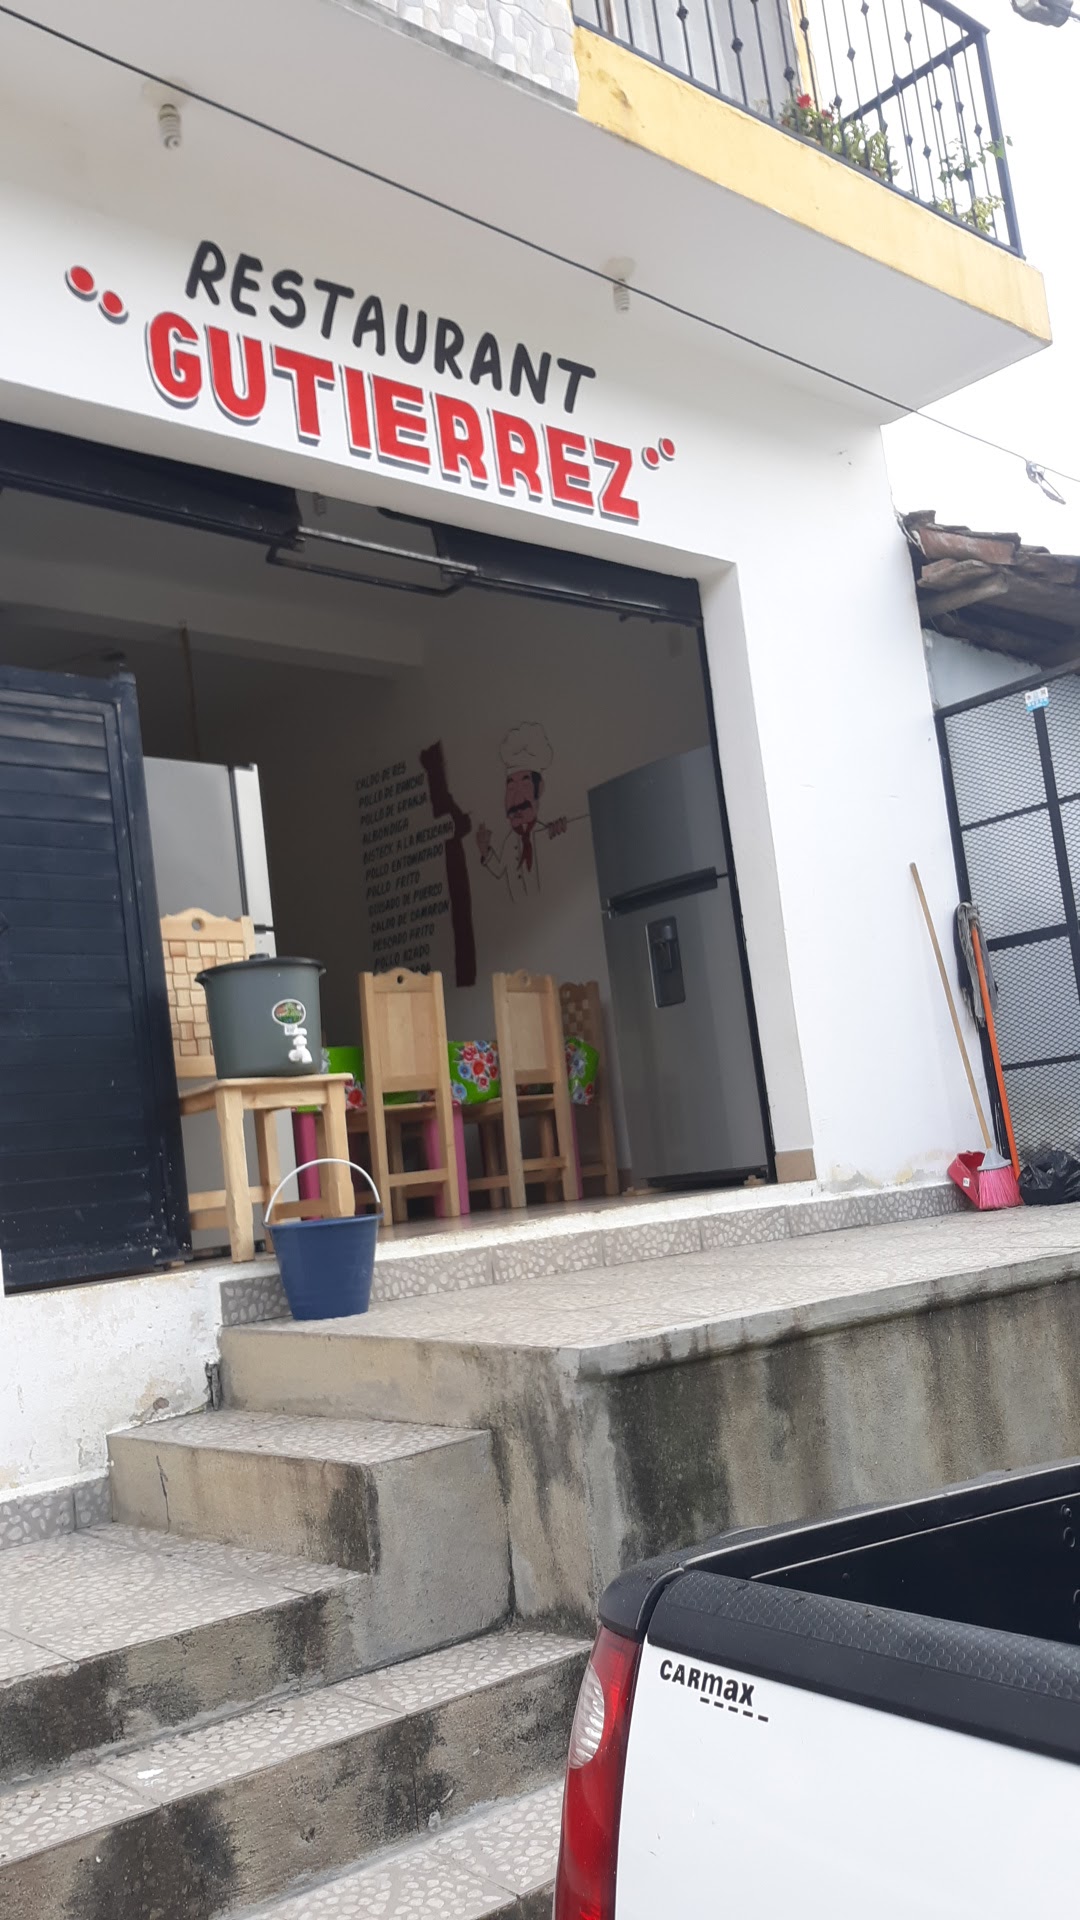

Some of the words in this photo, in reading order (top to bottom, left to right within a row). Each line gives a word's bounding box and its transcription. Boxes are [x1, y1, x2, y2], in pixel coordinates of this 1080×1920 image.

[185, 240, 596, 413] RESTAURANT
[145, 311, 640, 525] GUTIERREZ
[355, 771, 380, 791] CALDO
[381, 767, 391, 782] DE
[358, 790, 383, 808] POLLO
[384, 785, 393, 799] DE
[395, 773, 424, 794] RANCHO
[360, 807, 384, 826] POLLO
[385, 803, 394, 818] DE
[397, 792, 427, 813] GRANJA
[362, 817, 409, 844] ALBONDIGA
[363, 843, 393, 865] BISTECK
[397, 840, 403, 852] A
[404, 834, 415, 849] LA
[416, 821, 454, 844] MEXICANA
[365, 863, 390, 881] POLLO
[391, 843, 444, 873] ENTOMATADO
[366, 881, 391, 900] POLLO
[395, 870, 420, 890] FRITO
[402, 893, 411, 906] DE
[413, 882, 443, 903] PUERCO
[371, 916, 395, 934] CALDO
[397, 912, 407, 927] DE
[410, 900, 449, 922] CAMARON
[372, 931, 408, 953] PESCADO
[409, 923, 435, 942] FRITO
[373, 952, 400, 975] POLLO
